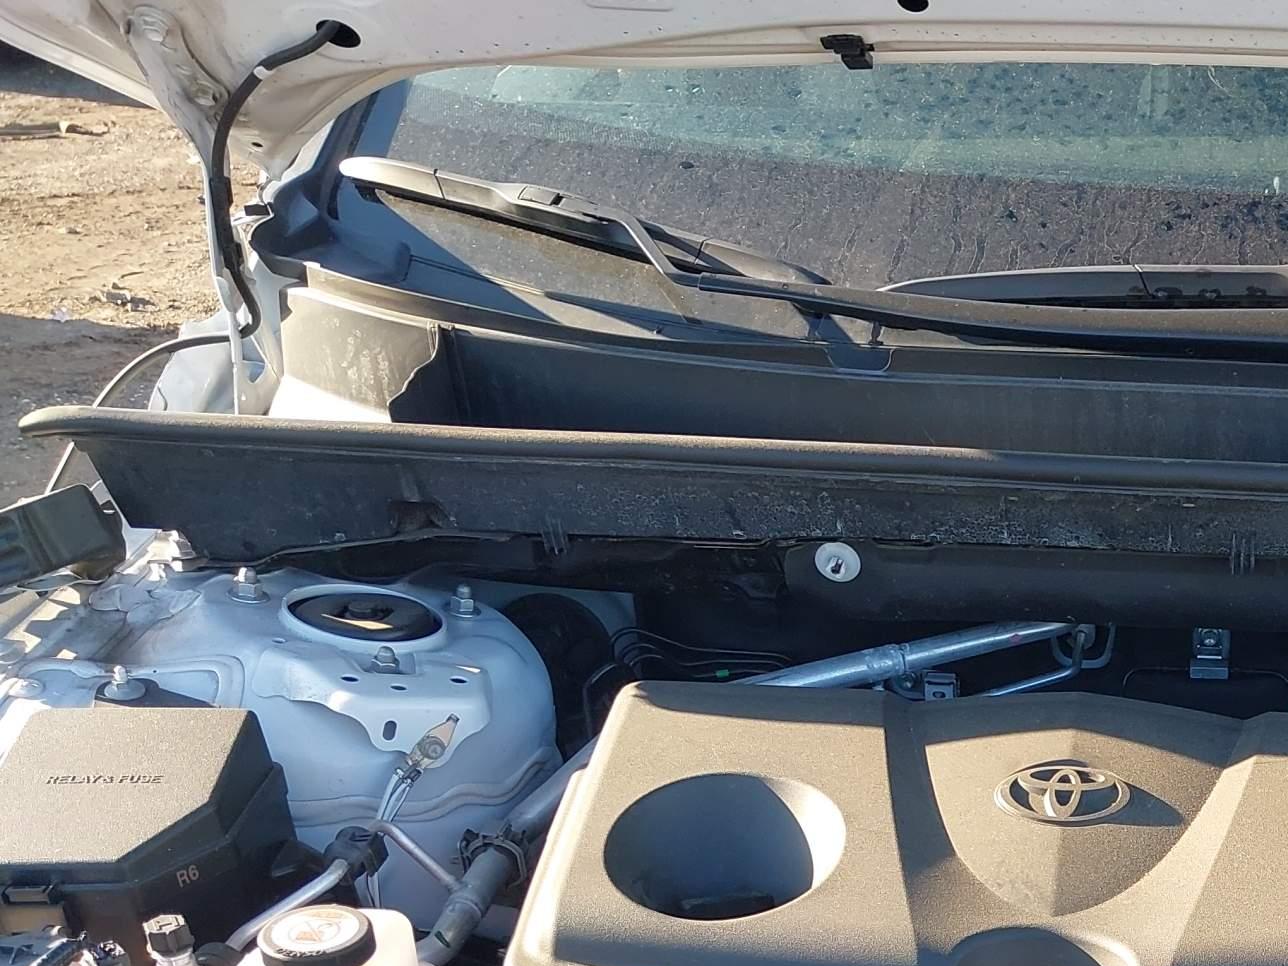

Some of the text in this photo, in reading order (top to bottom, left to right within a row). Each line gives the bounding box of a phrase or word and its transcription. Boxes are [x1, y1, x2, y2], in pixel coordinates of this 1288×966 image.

[46, 775, 102, 785] RELAY
[118, 775, 164, 785] FUSE
[176, 865, 199, 888] R6
